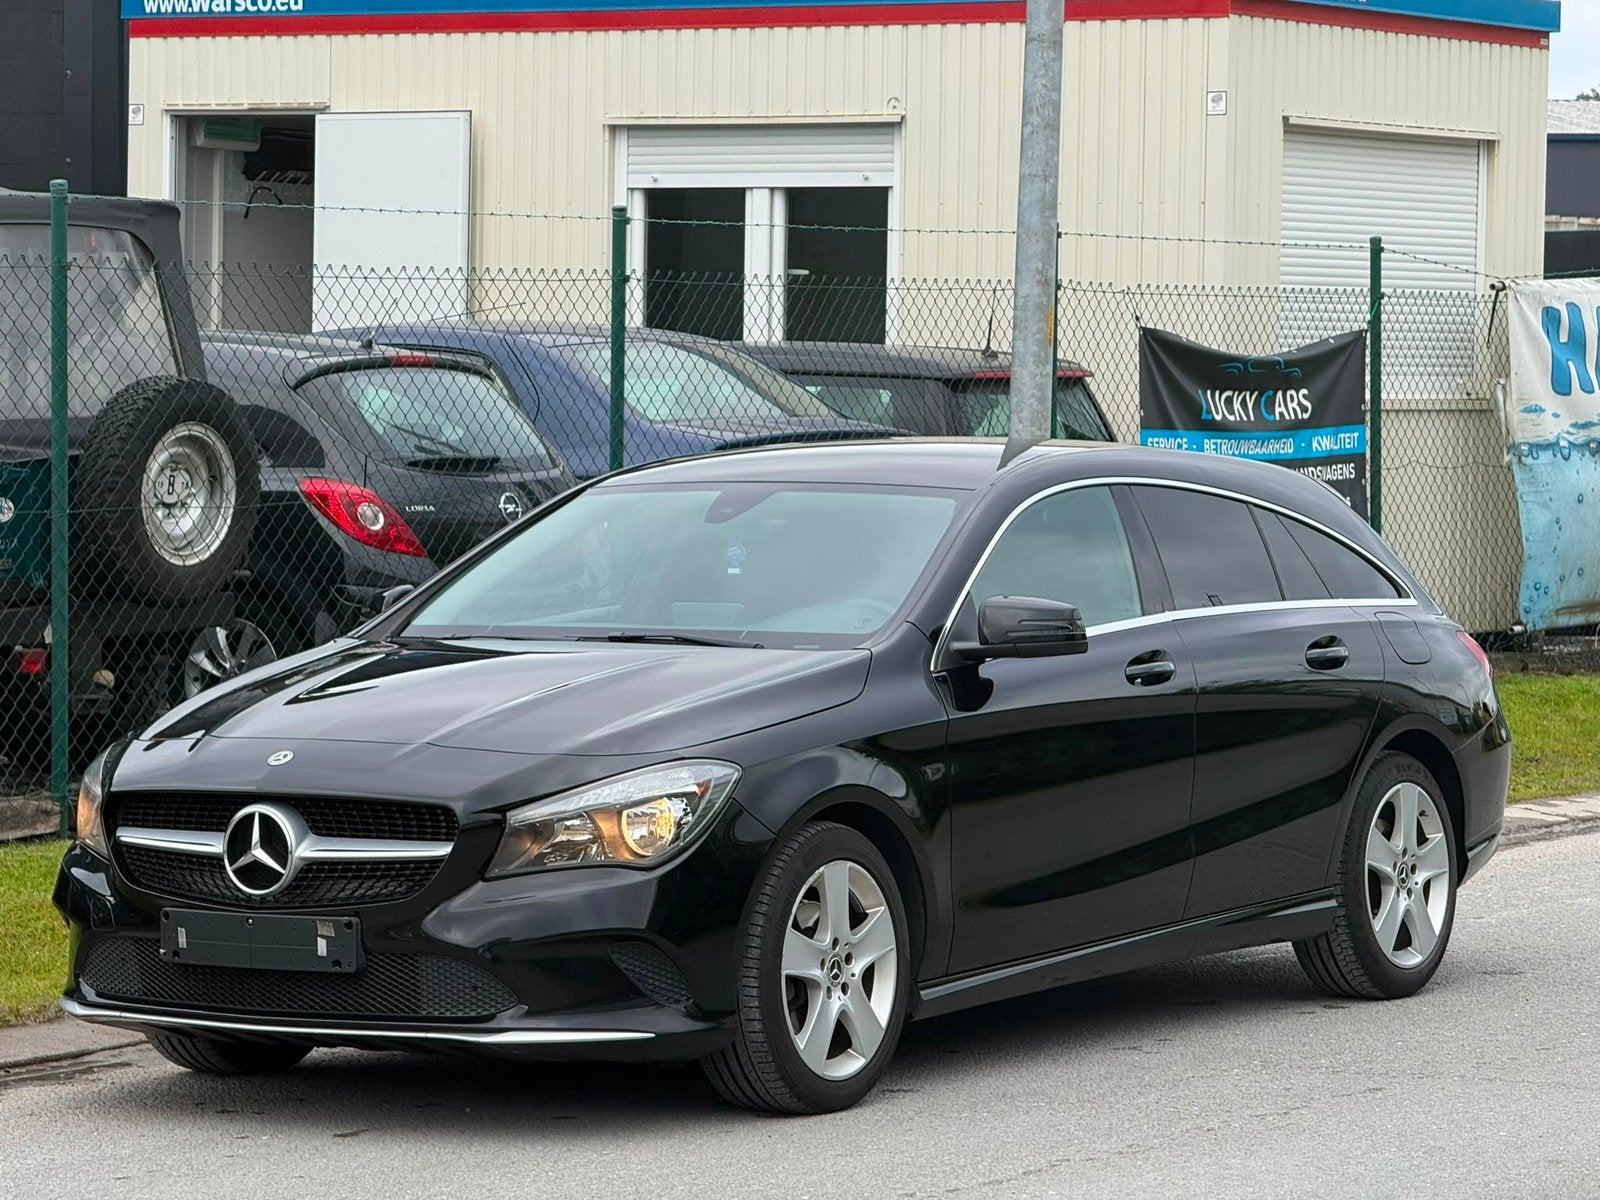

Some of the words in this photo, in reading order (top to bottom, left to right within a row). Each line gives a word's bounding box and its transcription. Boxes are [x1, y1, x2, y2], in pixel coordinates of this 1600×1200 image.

[143, 0, 304, 13] www.warsco.eu
[1198, 388, 1259, 421] LUCKY
[1260, 388, 1313, 421] CARS
[1203, 438, 1294, 455] BETROUWBAARHEID
[1311, 432, 1360, 452] KWALITEIT
